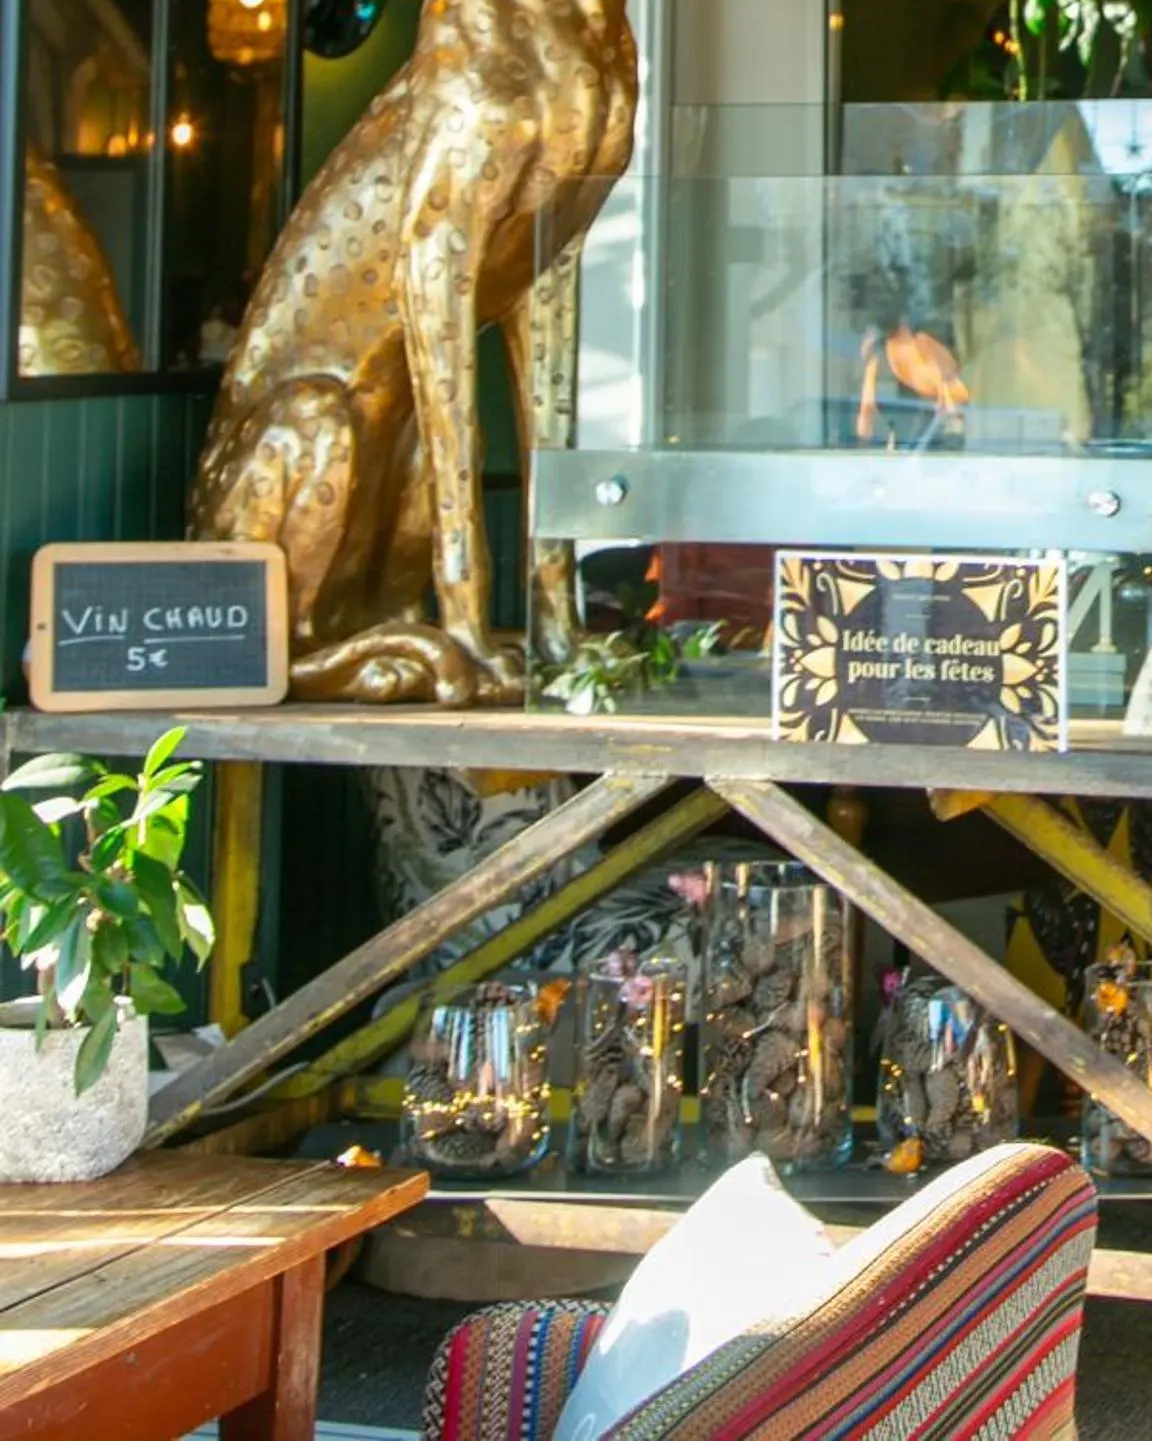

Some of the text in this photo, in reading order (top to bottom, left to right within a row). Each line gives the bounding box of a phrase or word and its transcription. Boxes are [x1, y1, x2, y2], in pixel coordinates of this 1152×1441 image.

[143, 605, 248, 630] CHAUD
[843, 629, 1000, 656] Idée de cadeau
[127, 646, 168, 671] 5€
[848, 658, 996, 684] pour les fêtes
